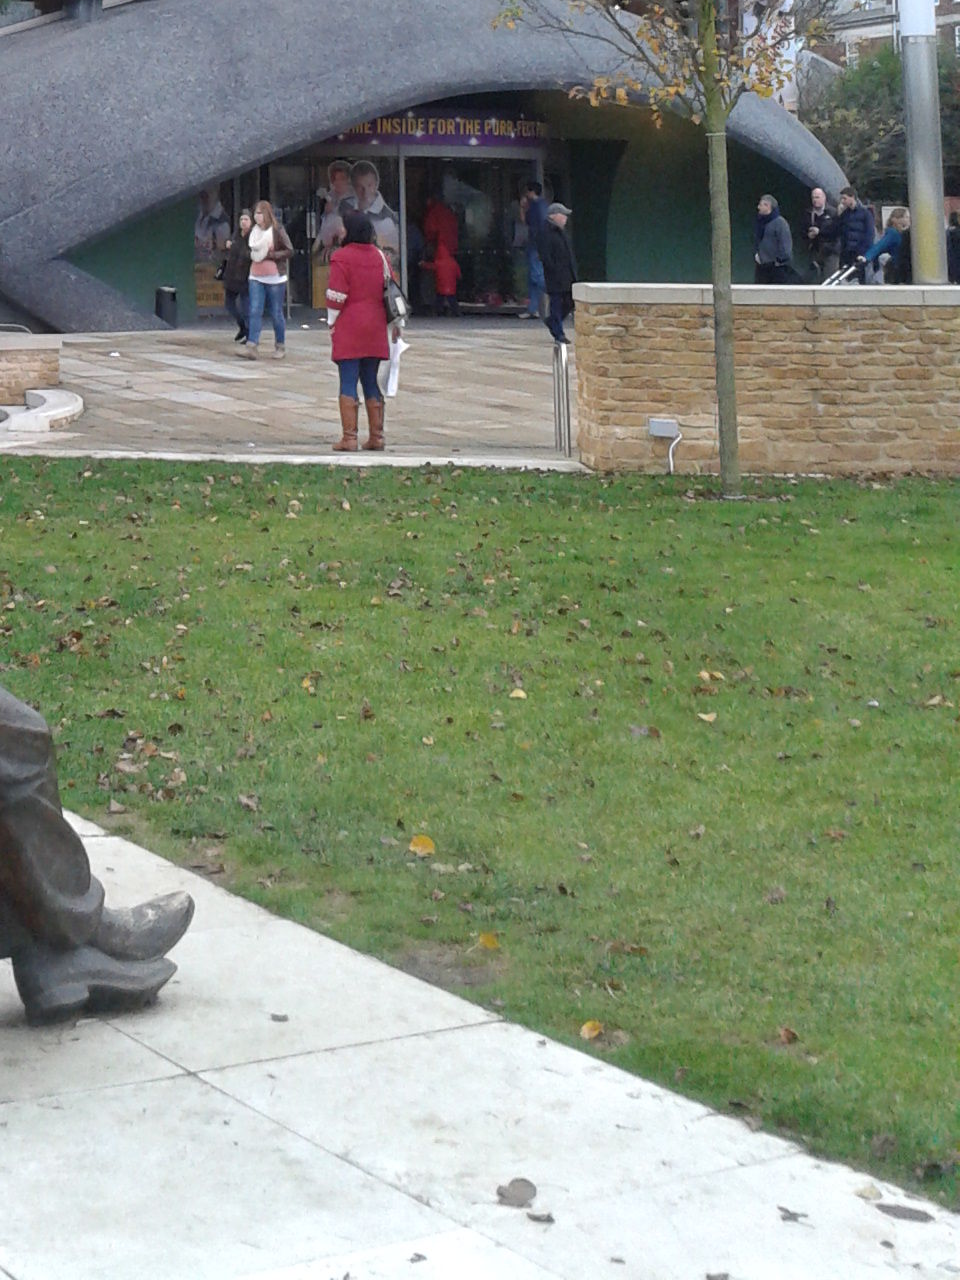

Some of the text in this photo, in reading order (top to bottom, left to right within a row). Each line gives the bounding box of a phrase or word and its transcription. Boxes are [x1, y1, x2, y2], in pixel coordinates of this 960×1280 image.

[377, 118, 424, 135] INSIDE
[428, 119, 456, 135] FOR
[459, 120, 482, 135] THE
